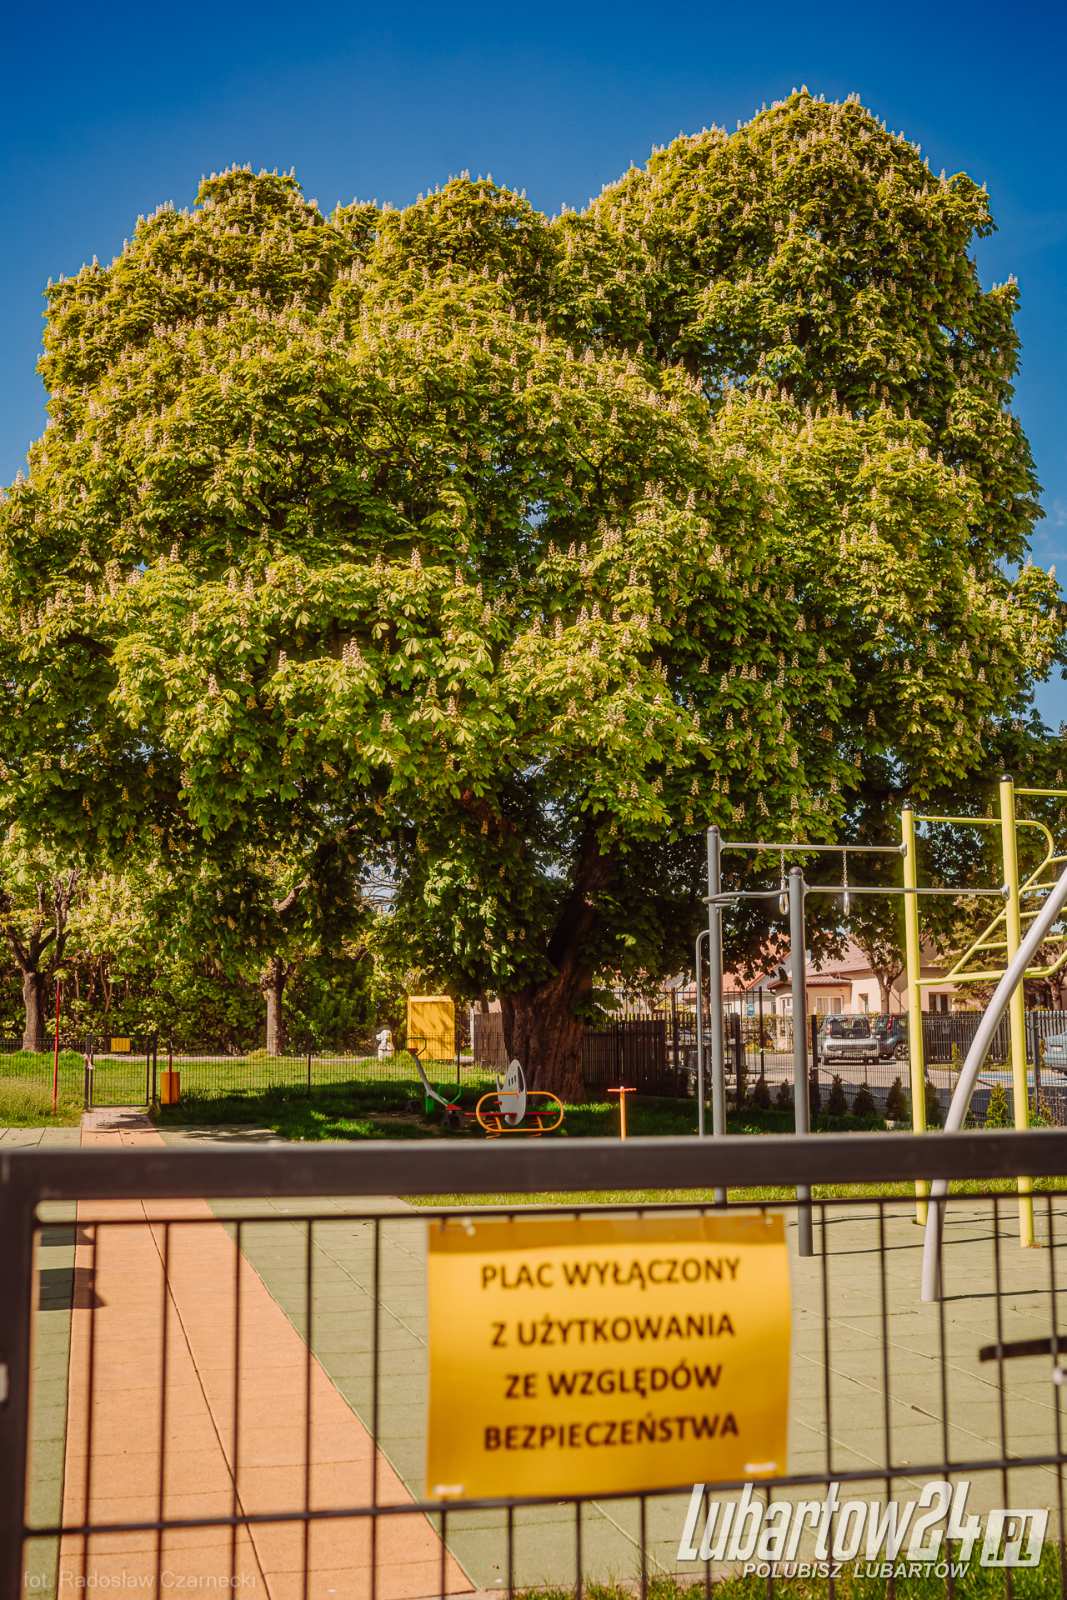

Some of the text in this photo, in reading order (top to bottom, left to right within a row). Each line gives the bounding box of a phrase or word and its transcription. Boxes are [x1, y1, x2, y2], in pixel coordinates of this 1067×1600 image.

[481, 1258, 740, 1290] PLAC WYŁĄCZONY
[491, 1313, 735, 1347] Z UŻYTKOWANIA
[505, 1360, 722, 1399] ZE WZGLĘDÓW
[484, 1412, 739, 1451] BEZPIECZEŃSTWA
